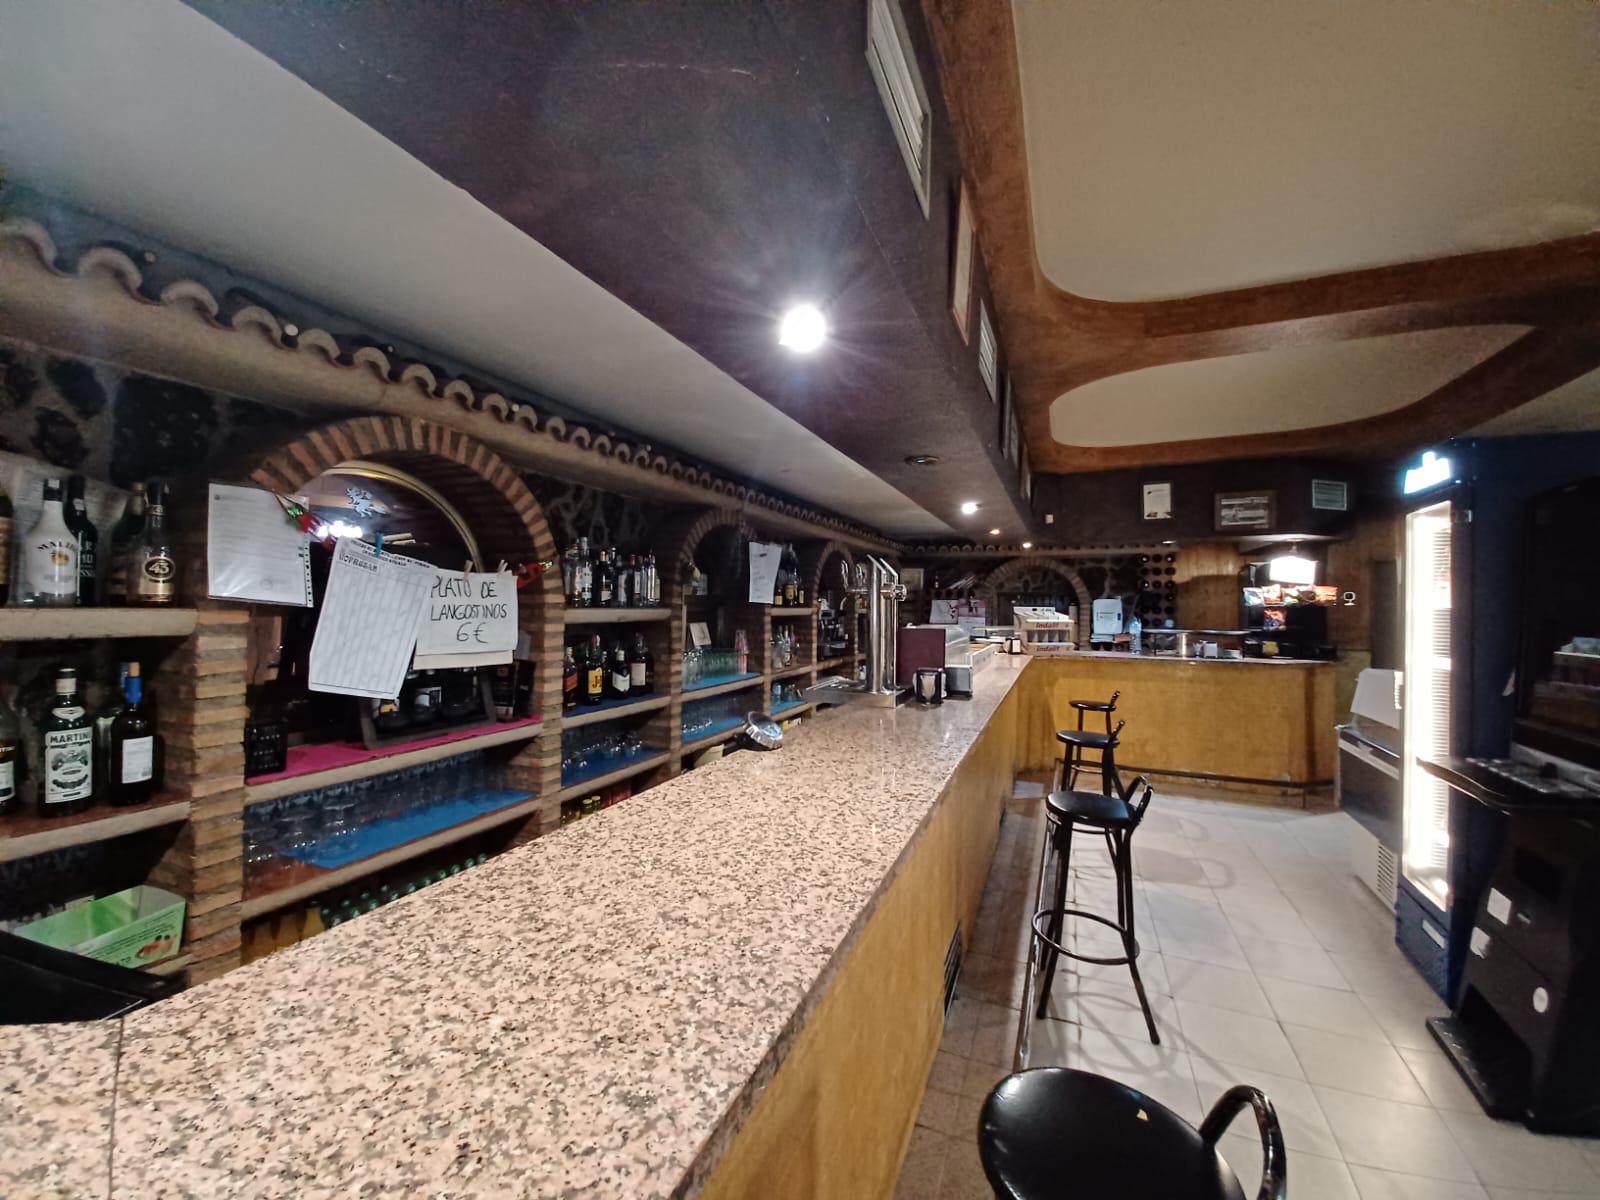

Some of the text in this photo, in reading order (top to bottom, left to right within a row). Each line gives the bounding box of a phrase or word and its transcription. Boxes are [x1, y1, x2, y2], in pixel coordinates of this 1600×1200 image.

[149, 562, 169, 574] 43
[430, 575, 498, 599] PLATO DE
[431, 603, 508, 621] LANGOSTINOS
[456, 621, 489, 644] 6€
